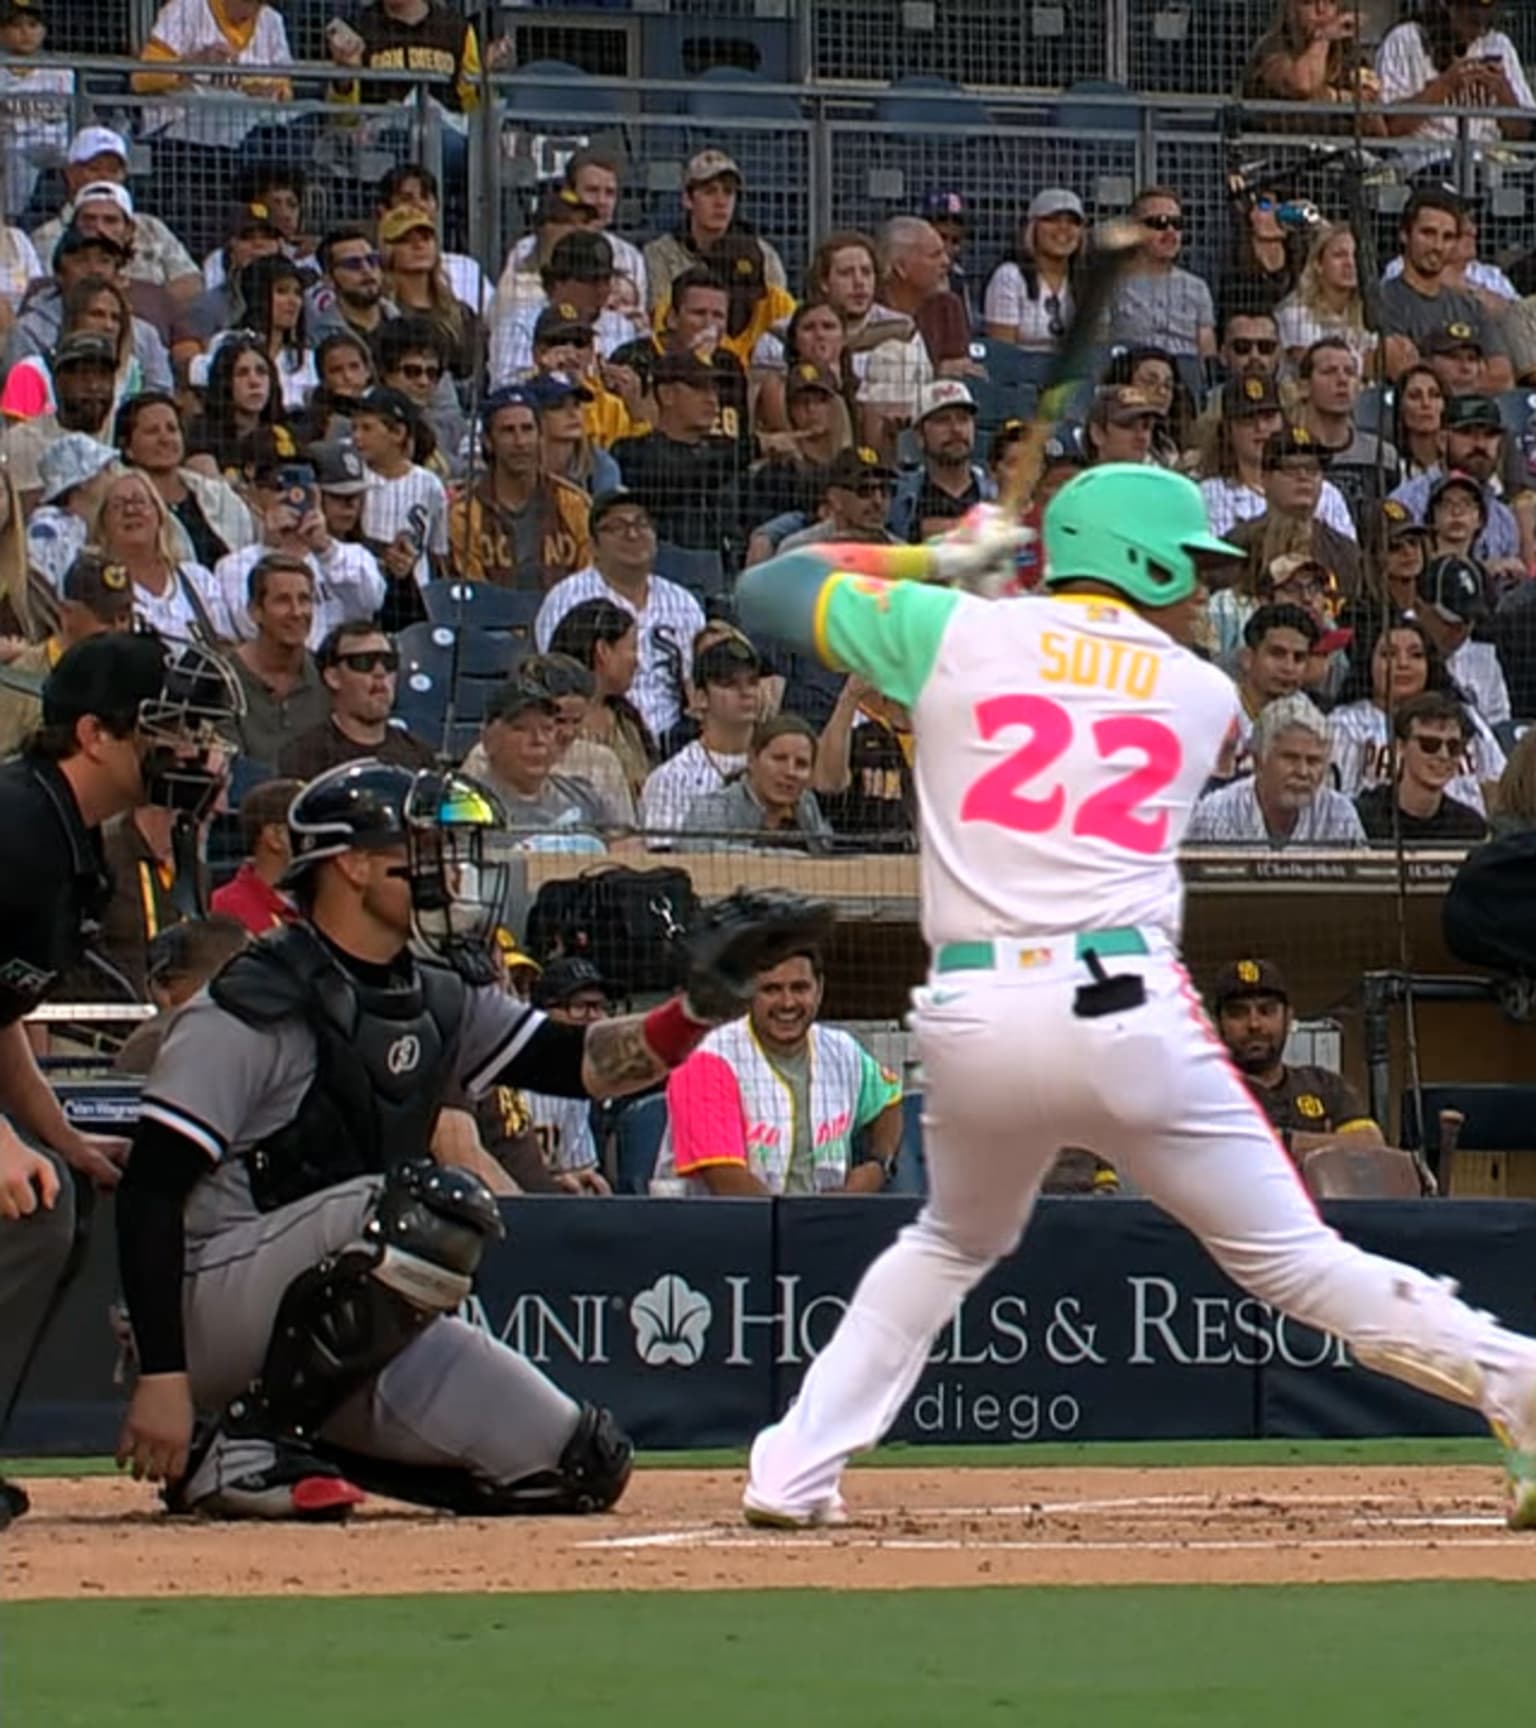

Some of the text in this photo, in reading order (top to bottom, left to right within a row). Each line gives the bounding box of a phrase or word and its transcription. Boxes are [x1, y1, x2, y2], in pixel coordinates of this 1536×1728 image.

[1038, 629, 1161, 701] SOTO
[960, 692, 1184, 856] 22
[457, 1293, 611, 1364] MNI
[1045, 1297, 1107, 1366] &
[913, 1381, 1081, 1440] diego
